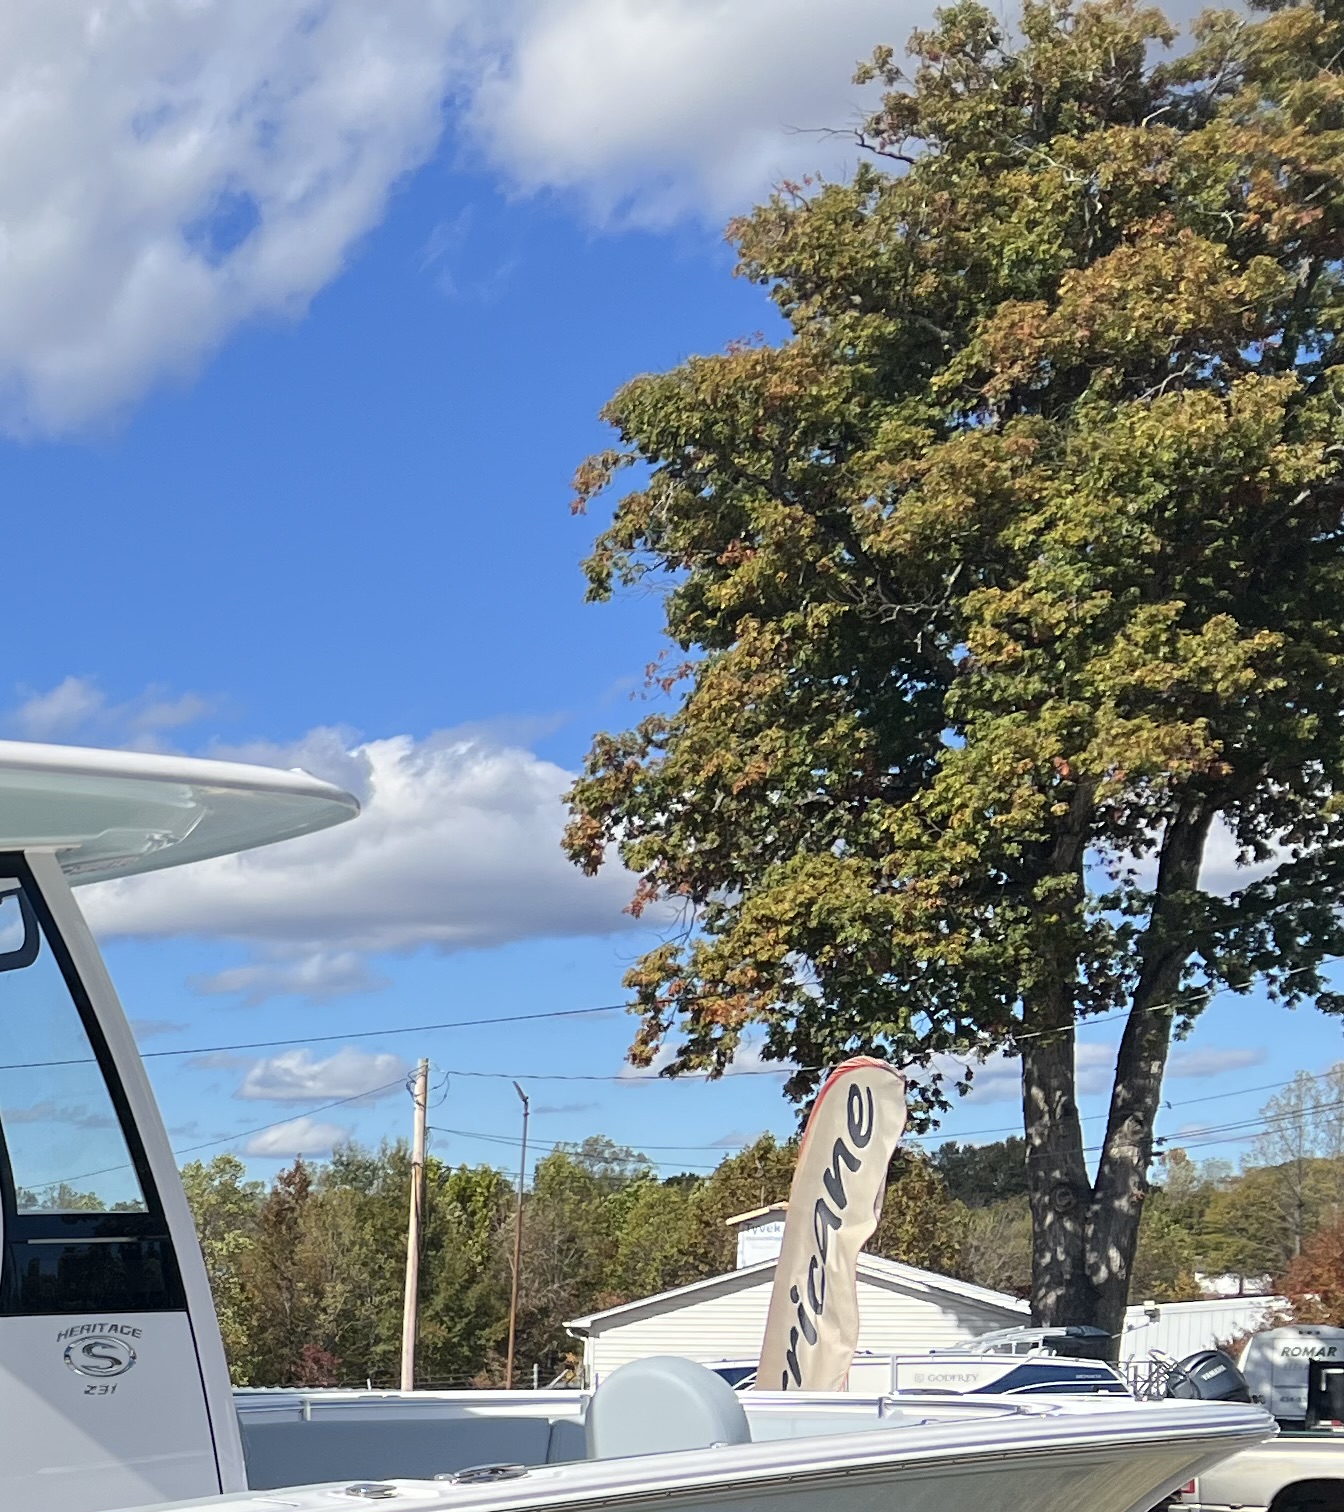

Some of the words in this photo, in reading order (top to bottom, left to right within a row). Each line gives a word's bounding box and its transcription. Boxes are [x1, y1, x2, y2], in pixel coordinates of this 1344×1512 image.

[56, 1323, 143, 1342] HERITAGE
[1280, 1346, 1338, 1357] ROMAR
[83, 1383, 118, 1395] 231
